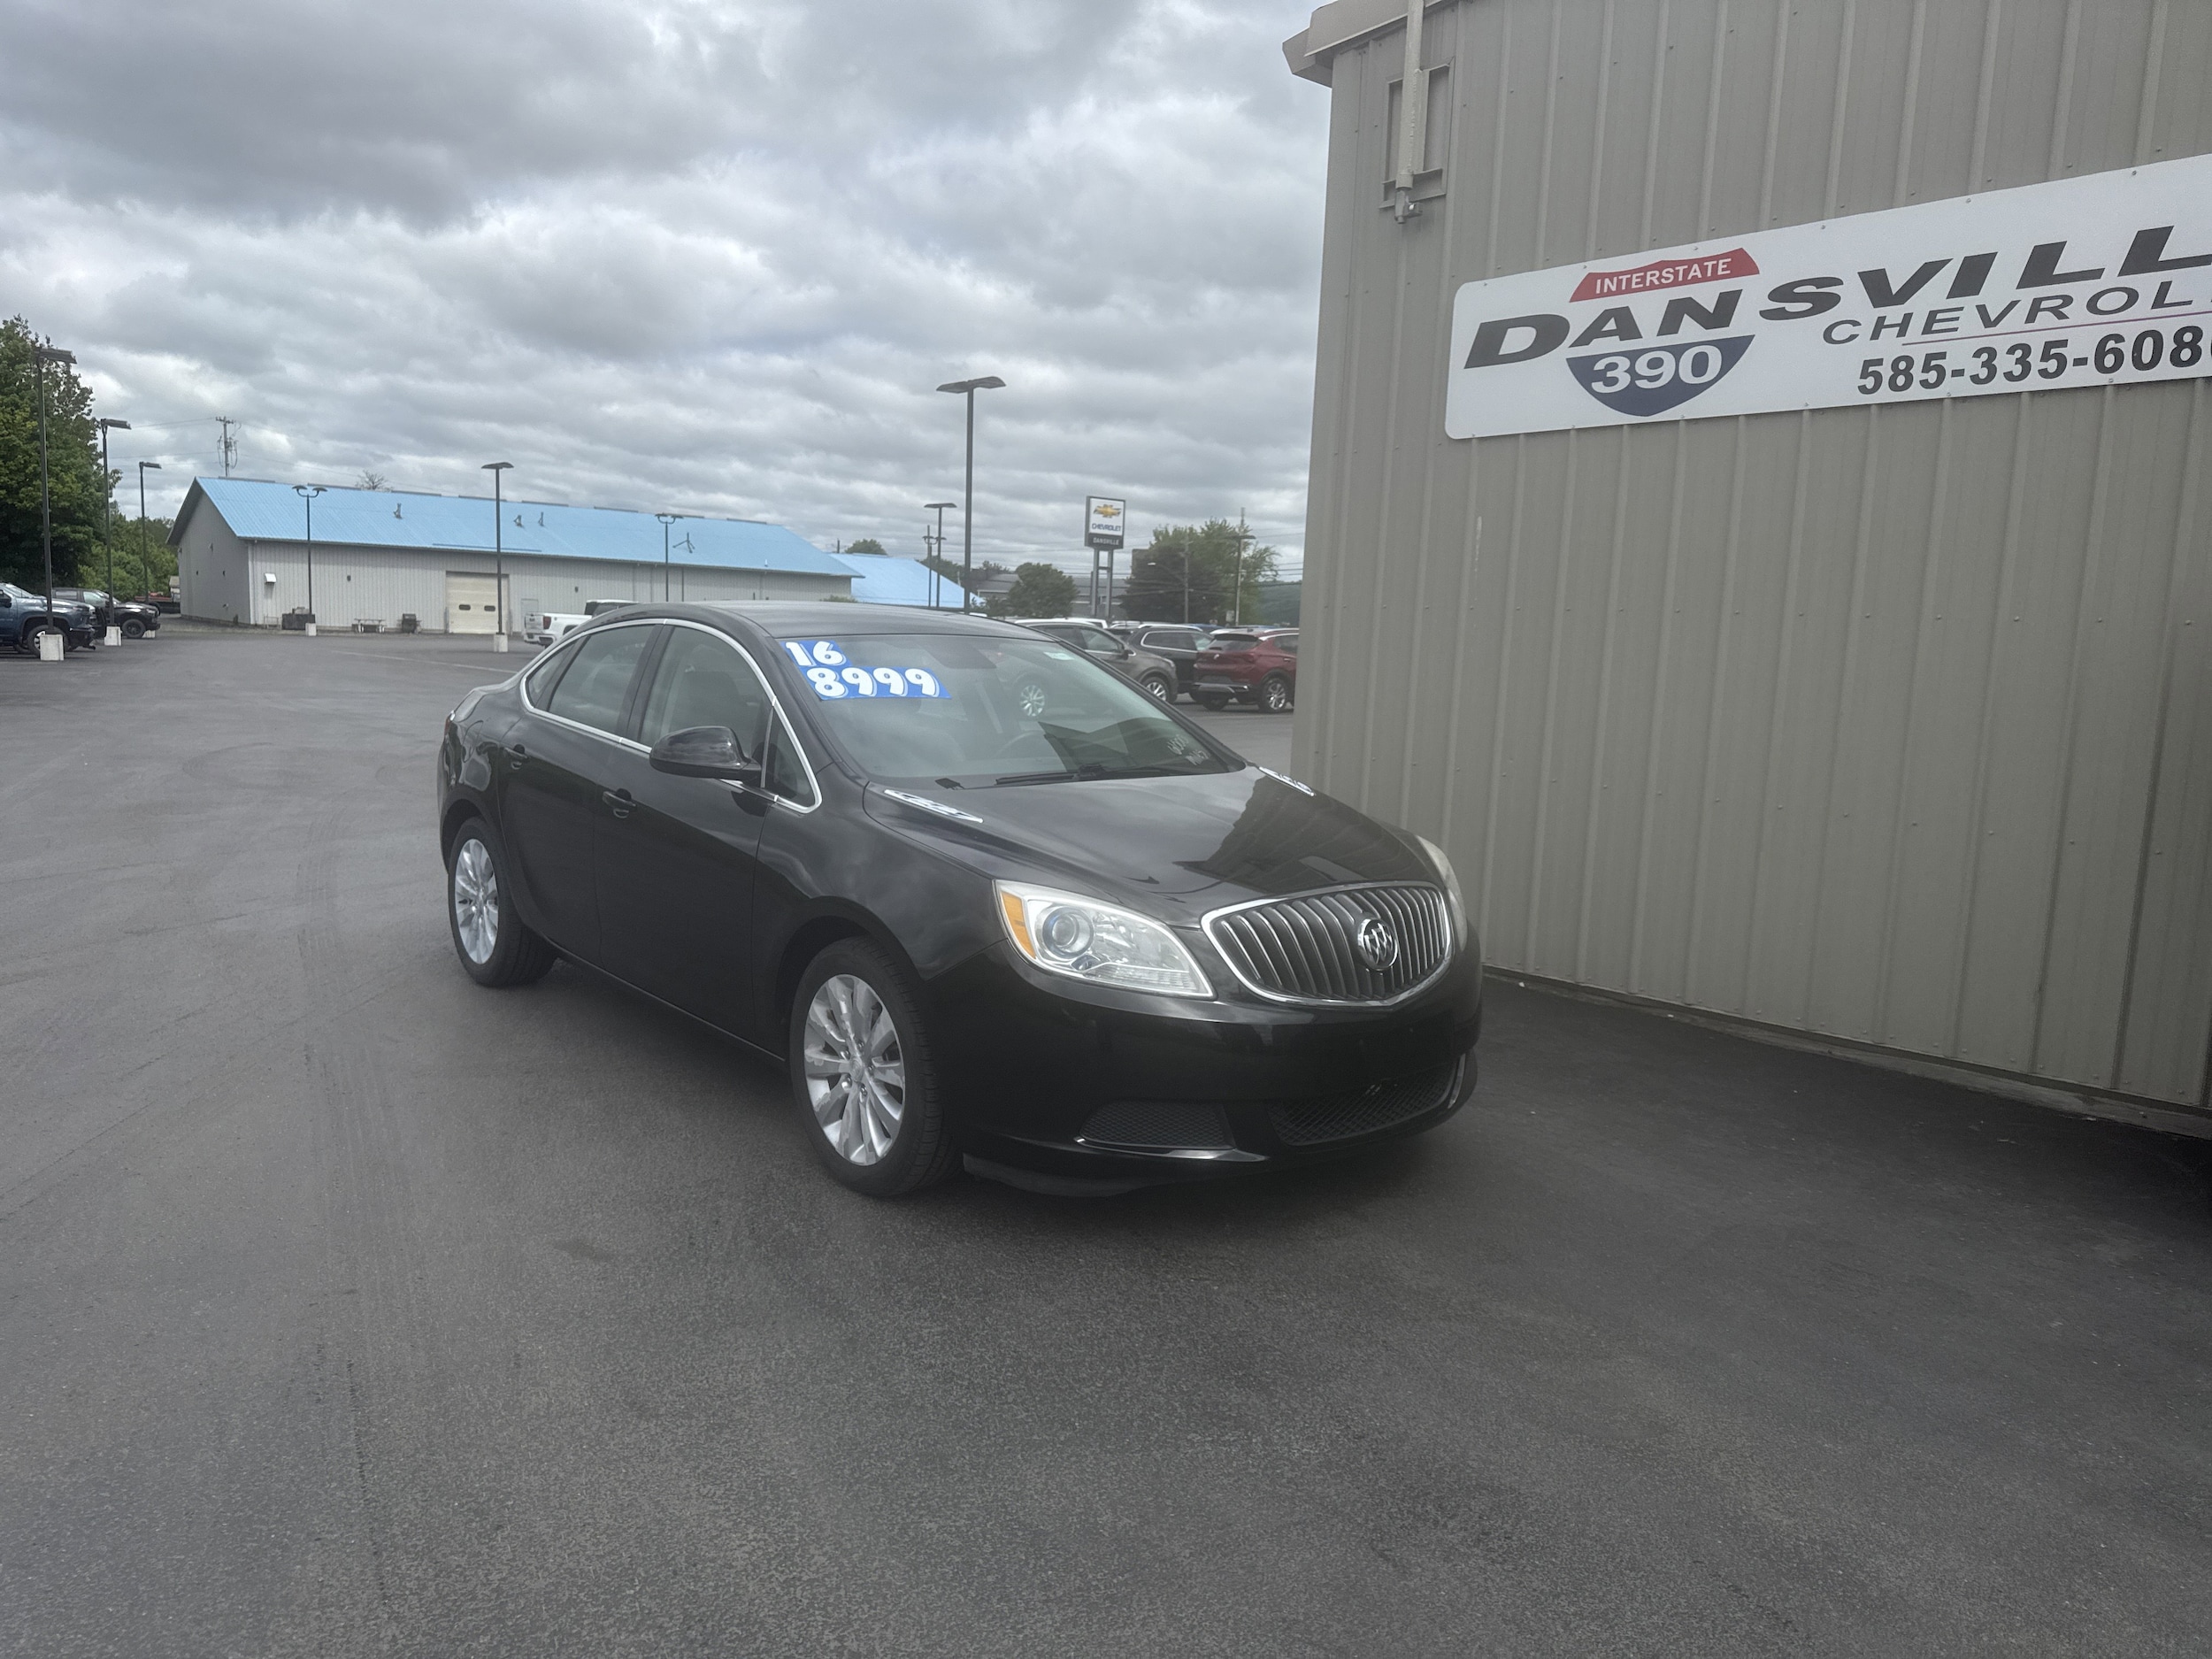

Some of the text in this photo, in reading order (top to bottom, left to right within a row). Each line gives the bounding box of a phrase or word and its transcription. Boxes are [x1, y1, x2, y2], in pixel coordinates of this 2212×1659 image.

[1595, 257, 1732, 295] INTERSTATE
[1823, 280, 2212, 345] CHEVROL
[1591, 345, 1723, 394] 390
[1857, 326, 2212, 395] 585-335-608
[1092, 523, 1121, 532] CHEVROLET
[785, 641, 846, 666] 16
[806, 667, 940, 698] 8999
